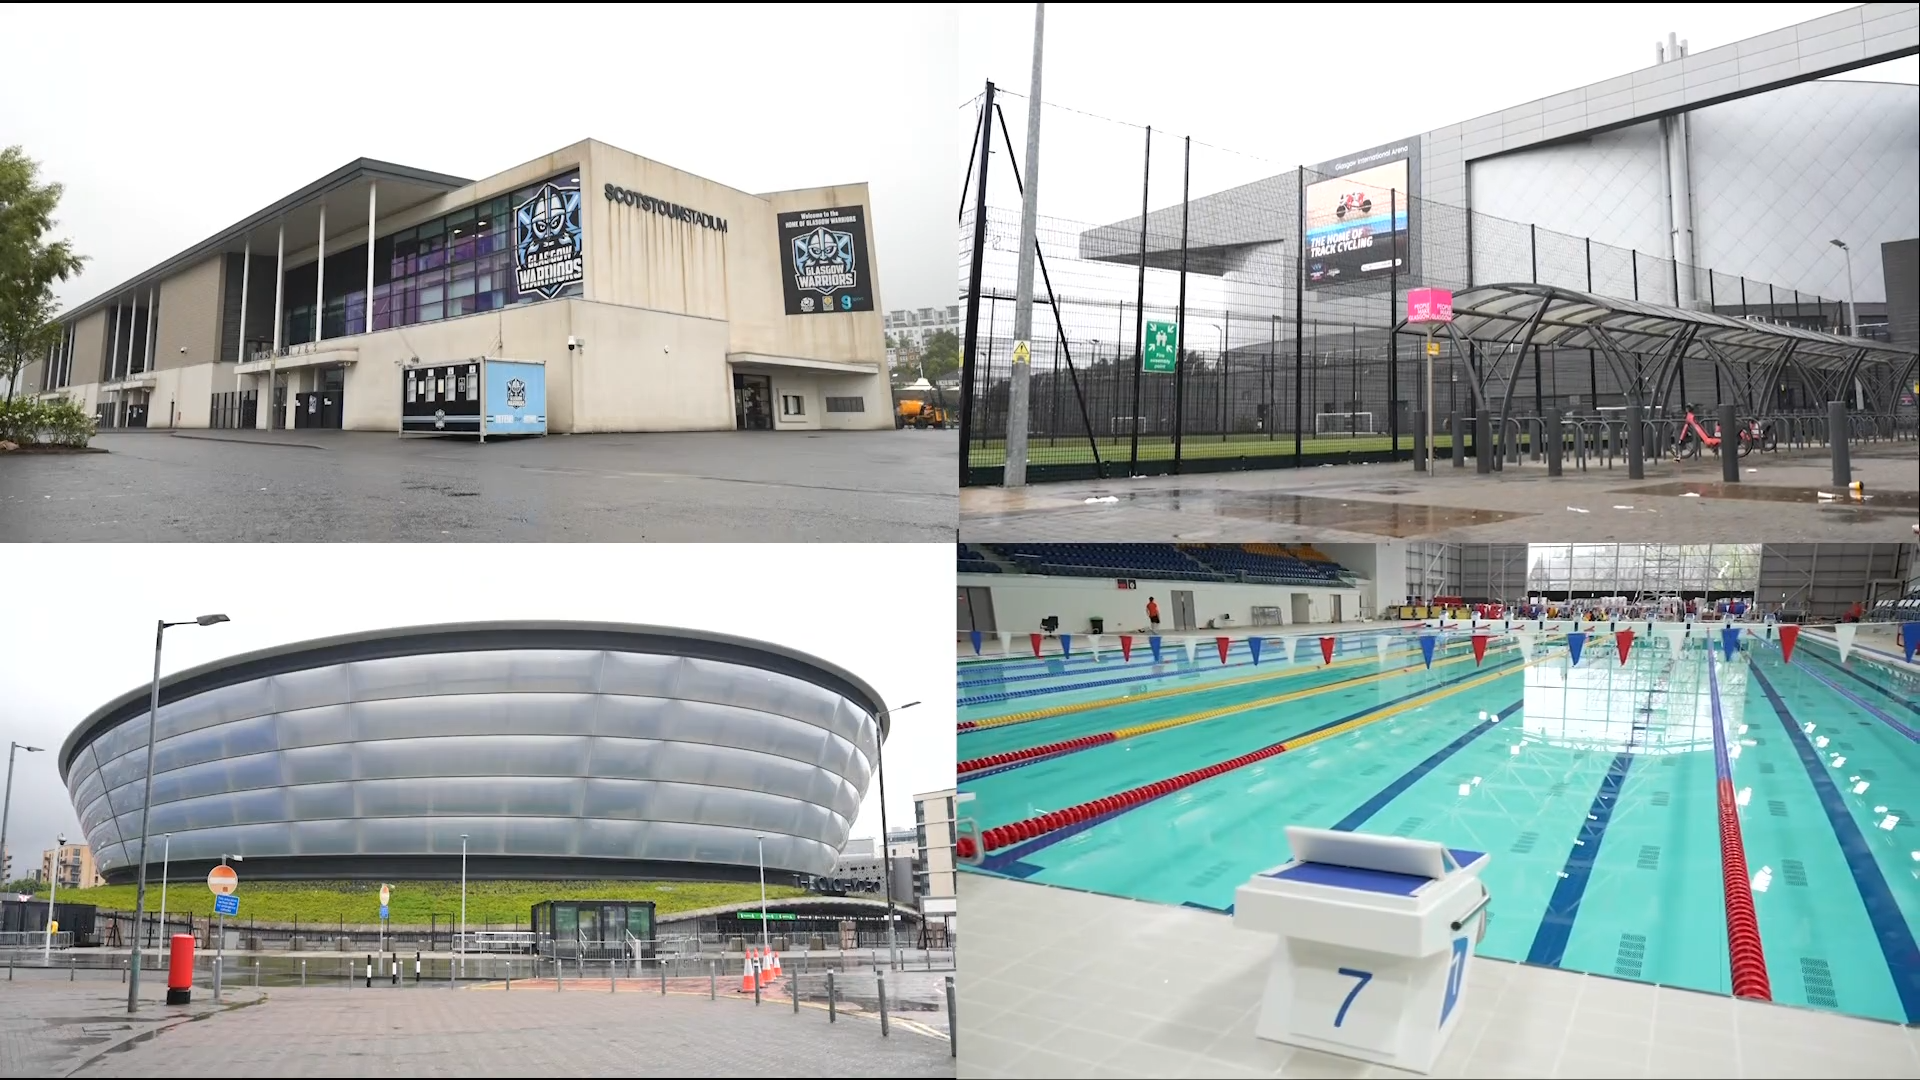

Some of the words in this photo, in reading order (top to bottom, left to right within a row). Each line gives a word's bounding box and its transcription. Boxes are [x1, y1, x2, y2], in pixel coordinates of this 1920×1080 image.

[1334, 160, 1357, 171] Glasgow
[1357, 149, 1391, 165] International
[1391, 145, 1409, 156] Arena
[785, 221, 799, 229] HOME
[806, 218, 830, 227] GLASGOW
[830, 215, 857, 224] WARRIORS
[800, 212, 823, 220] Welcome
[1310, 235, 1327, 248] THE
[1351, 228, 1364, 240] OF
[1310, 243, 1336, 258] TRACK
[1337, 235, 1374, 253] CYCLING
[527, 245, 573, 269] GLASGOW
[519, 257, 583, 290] WARRIORS
[798, 272, 854, 288] WARRIORS
[805, 264, 845, 276] GLASGOW
[1333, 967, 1373, 1028] 7
